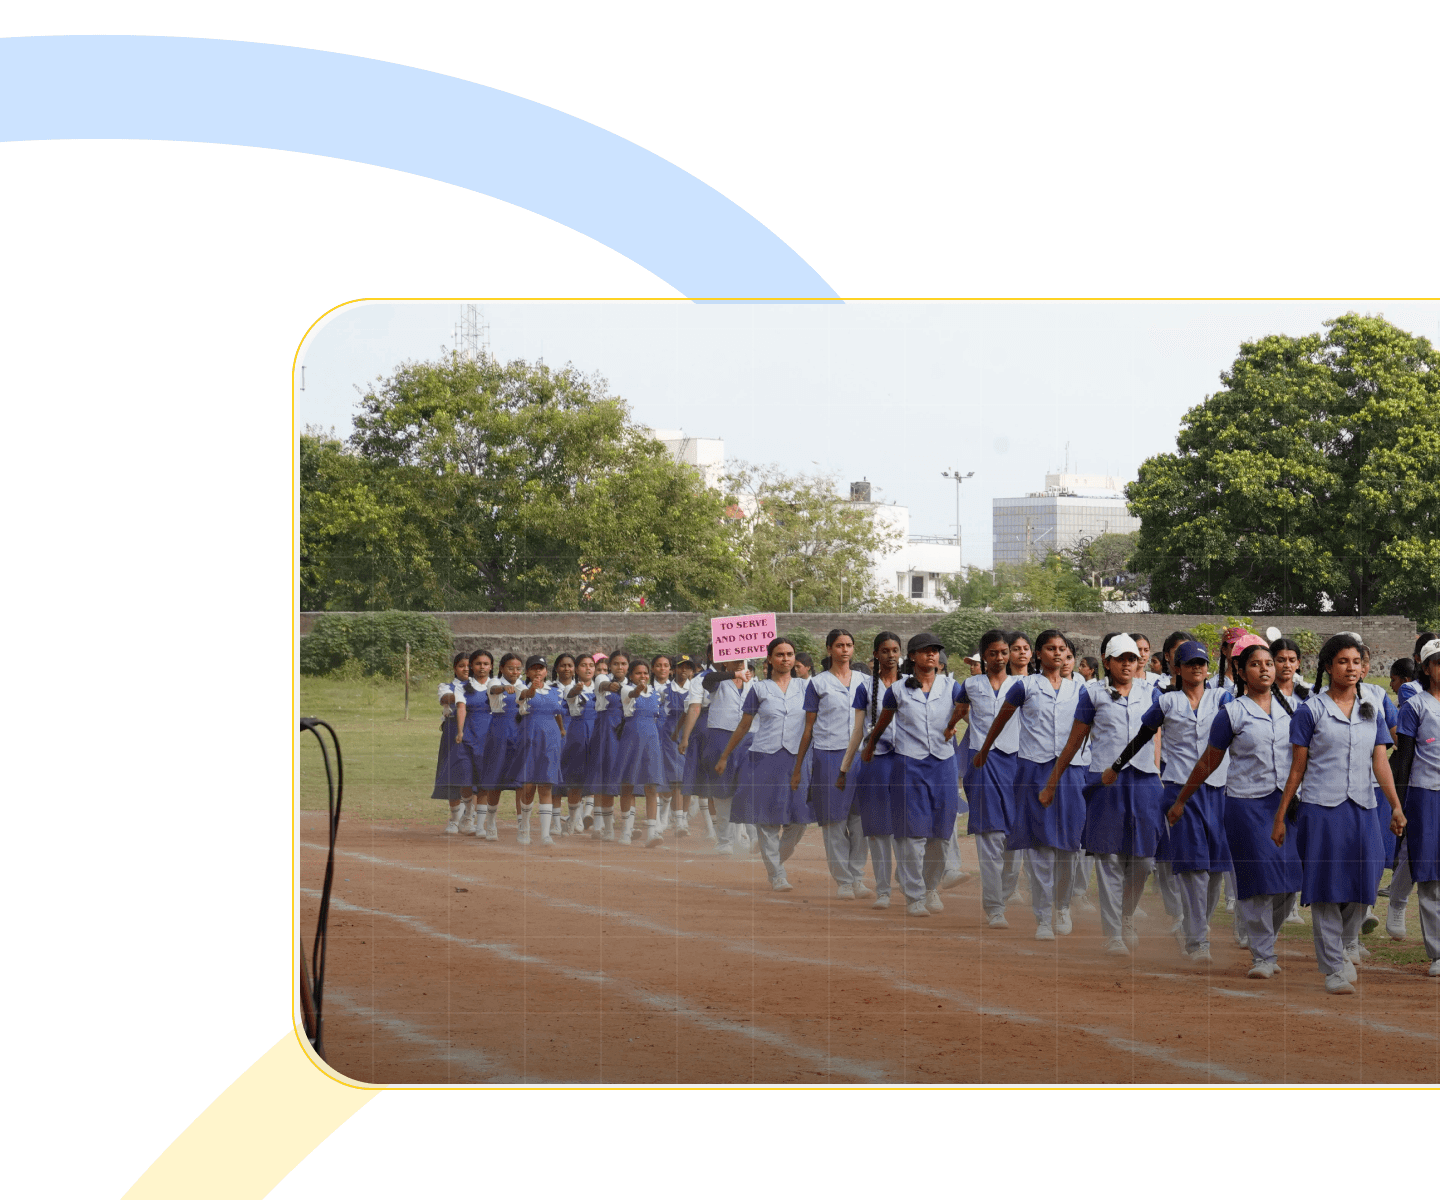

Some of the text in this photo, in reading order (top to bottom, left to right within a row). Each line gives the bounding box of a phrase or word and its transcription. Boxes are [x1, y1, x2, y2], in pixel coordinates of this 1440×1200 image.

[720, 619, 767, 630] TO SERVE
[715, 631, 774, 644] AND NOT TO
[718, 648, 731, 656] BE
